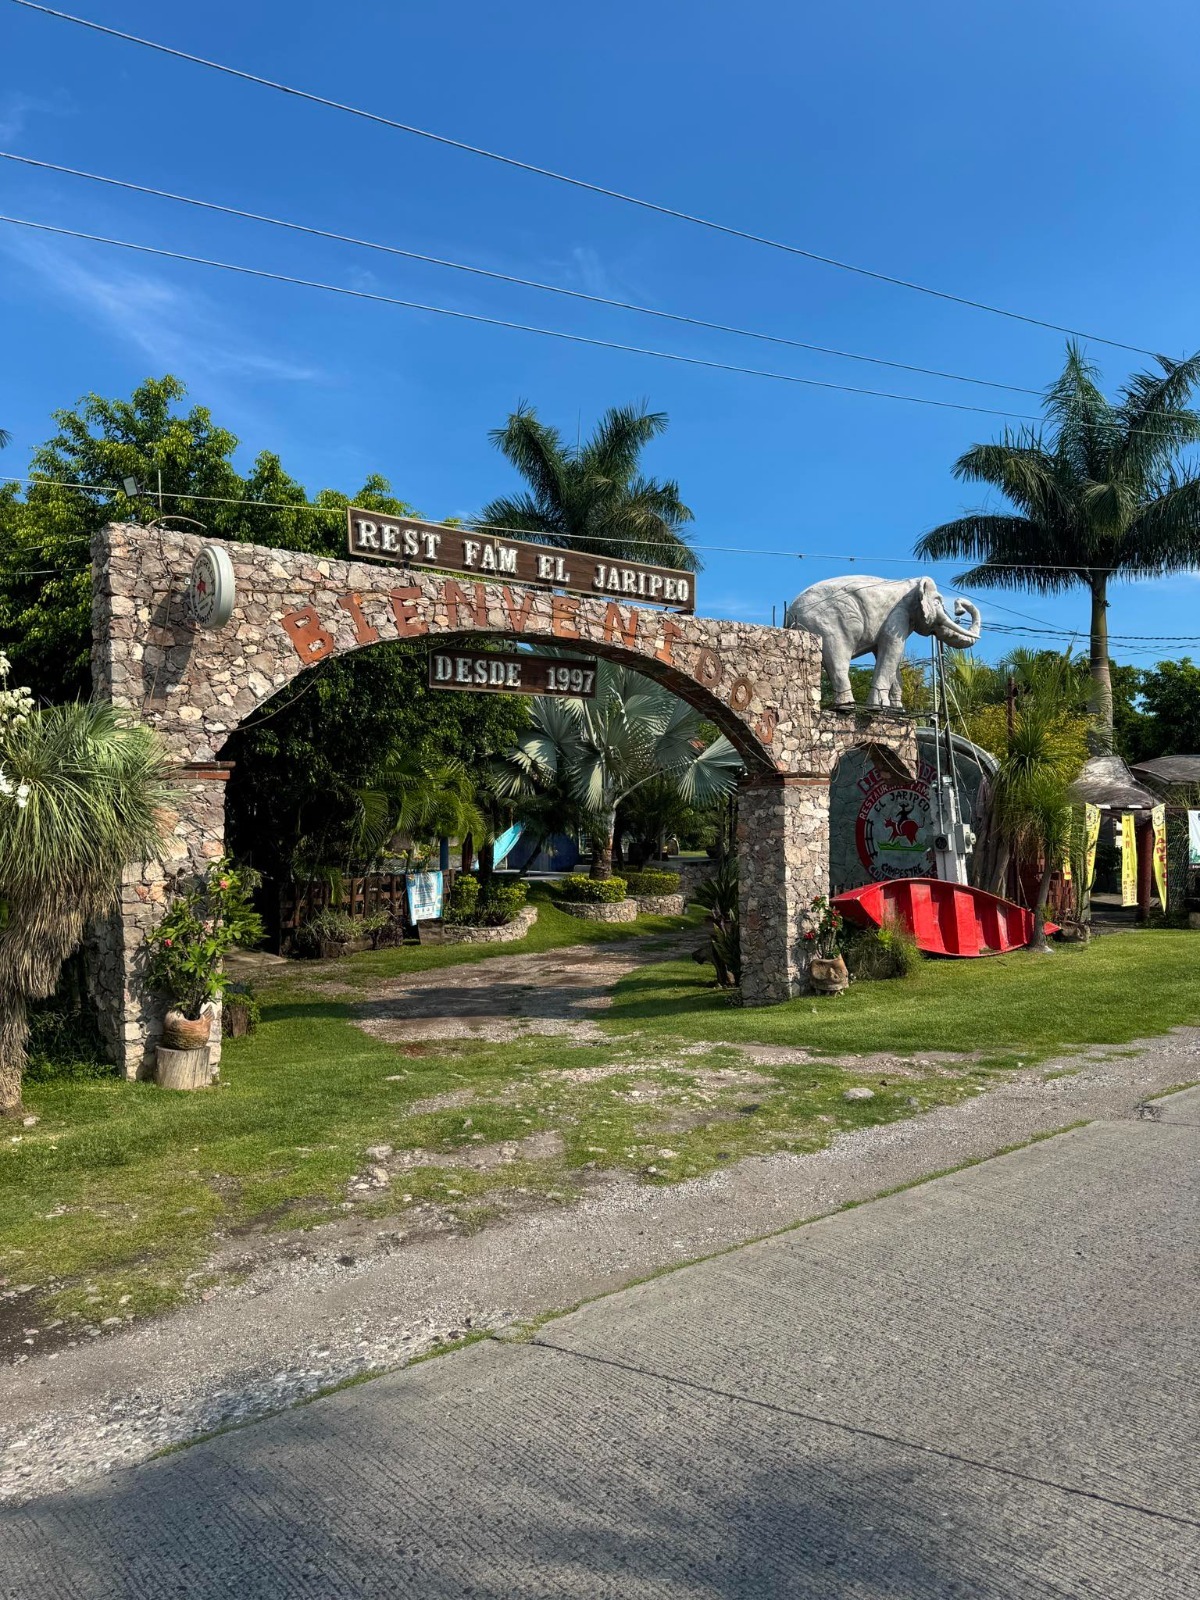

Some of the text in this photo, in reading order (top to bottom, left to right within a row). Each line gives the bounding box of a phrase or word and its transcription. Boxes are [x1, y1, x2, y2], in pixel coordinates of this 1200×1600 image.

[356, 518, 690, 602] REST FAM EL JARIPEO
[281, 580, 777, 744] BIENVENIDOS
[434, 654, 595, 693] DESDE 1997
[874, 791, 930, 812] EL JARIPEO
[881, 863, 923, 877] CAMPESTRE
